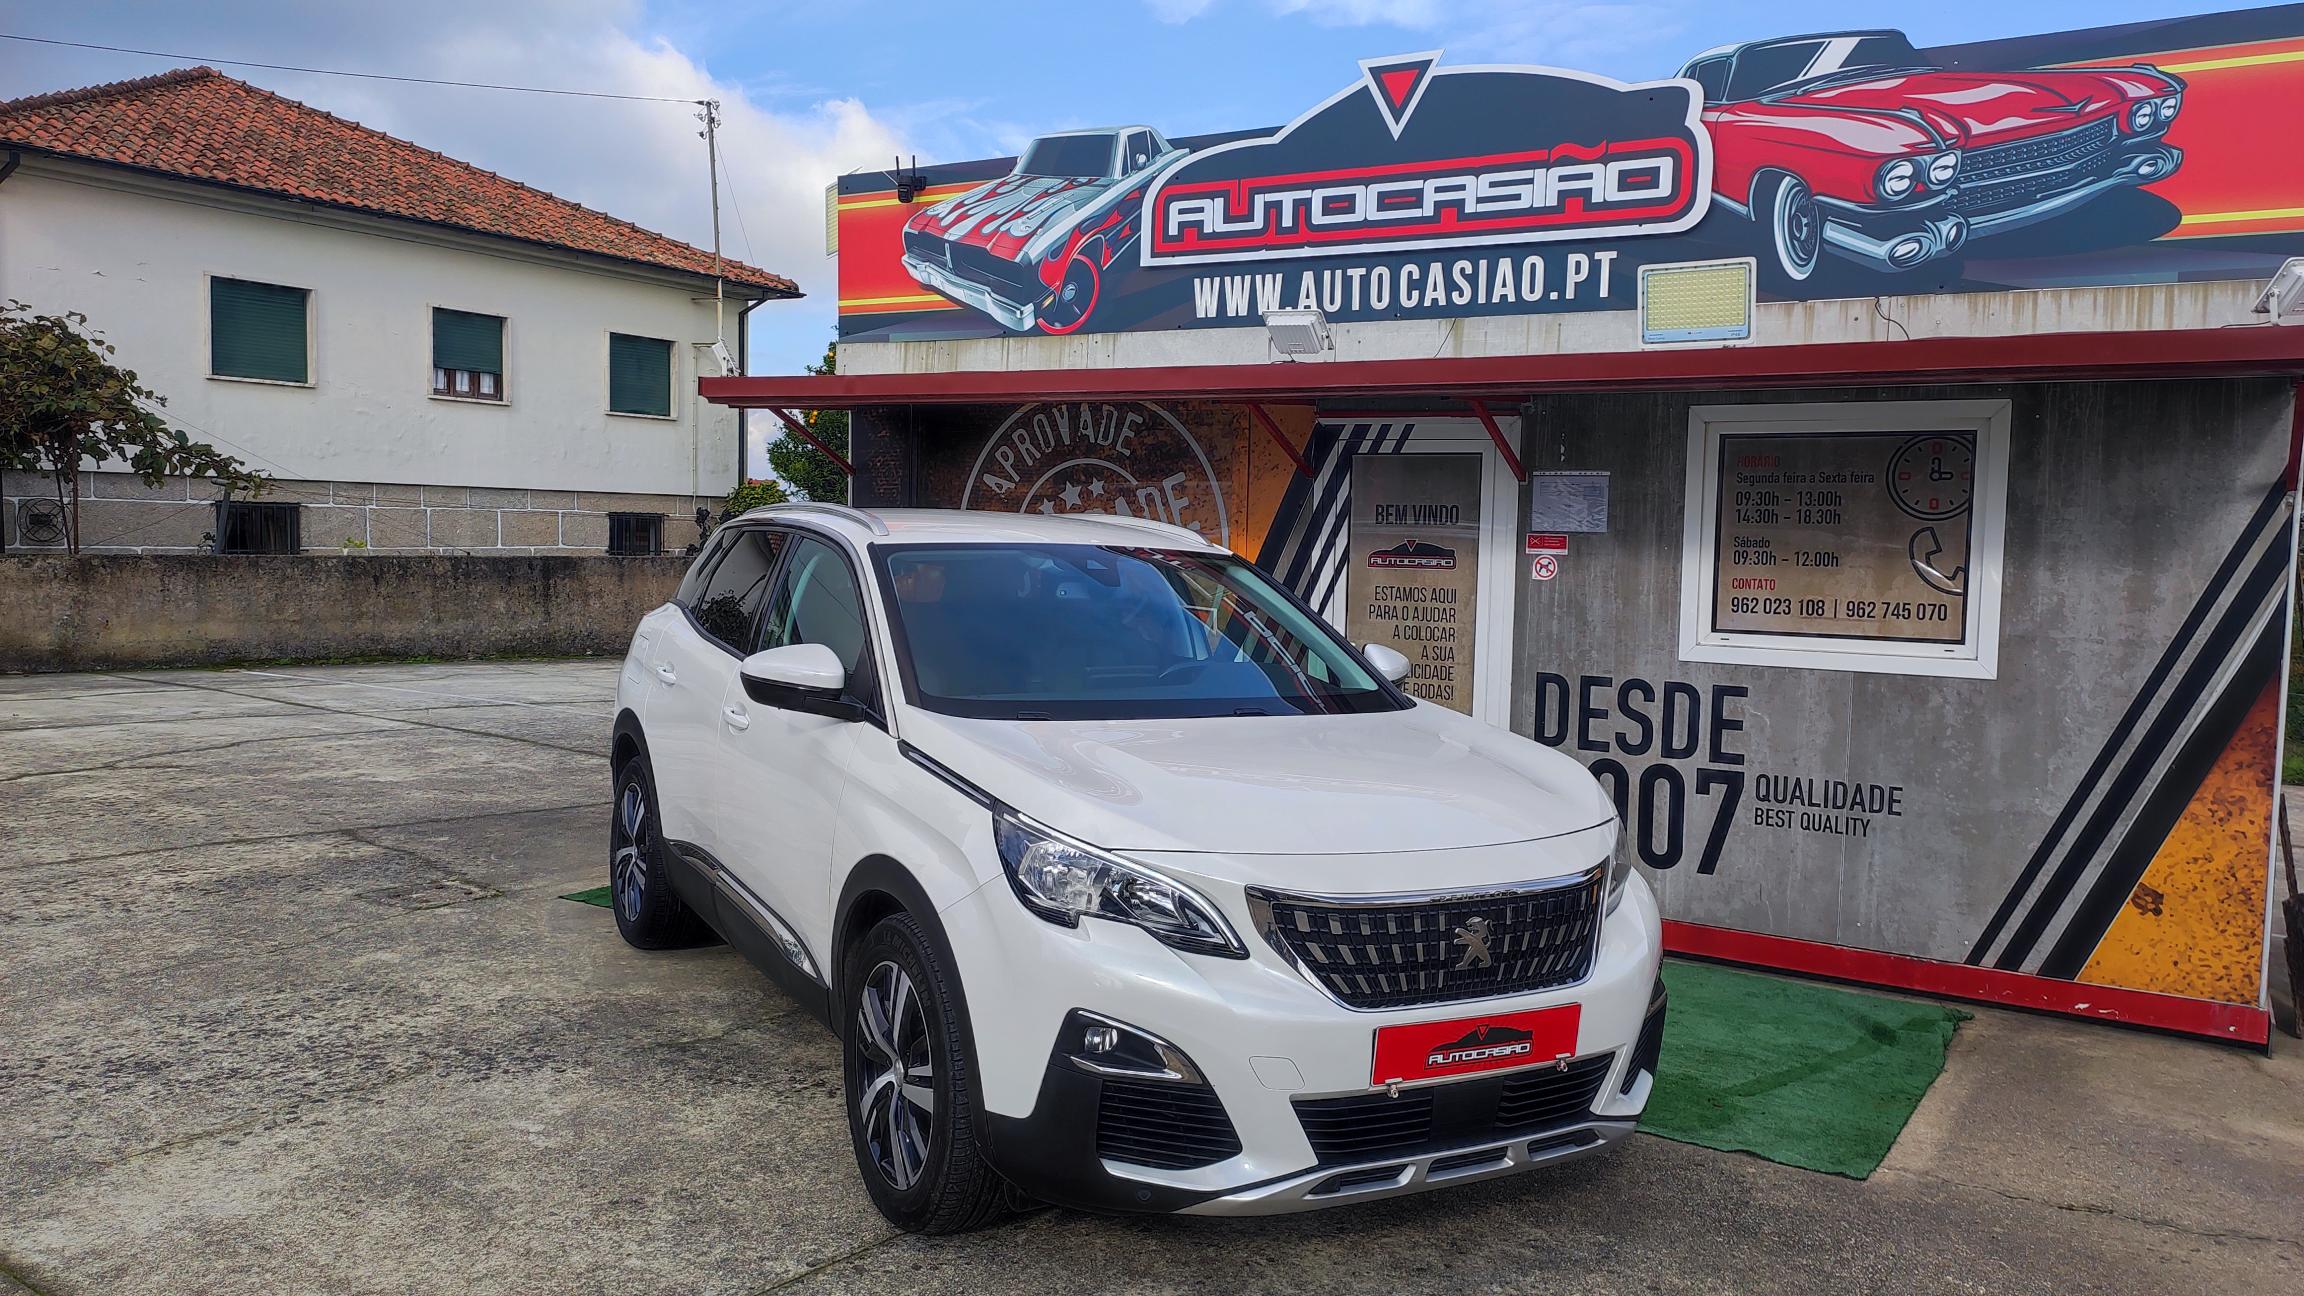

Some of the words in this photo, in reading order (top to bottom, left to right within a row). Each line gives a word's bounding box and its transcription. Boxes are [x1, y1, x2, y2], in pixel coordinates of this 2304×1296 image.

[1168, 141, 1674, 236] AUTOCASIÃO
[982, 402, 1144, 495] APROVADE
[1736, 471, 1780, 486] Segunda
[1782, 471, 1806, 484] feira
[1809, 474, 1816, 484] a
[1818, 471, 1847, 484] Sexta
[1850, 471, 1875, 484] feira
[1735, 490, 1780, 507] 09:30h
[1797, 490, 1842, 507] 13:00h
[1375, 504, 1408, 525] BEM
[1412, 504, 1460, 526] VINDO
[1735, 507, 1779, 525] 14:30h
[1796, 508, 1841, 525] 18.30h
[1733, 536, 1771, 549] Sábado
[1733, 550, 1777, 566] 09:30h
[1794, 551, 1839, 568] 12:00h
[1732, 577, 1776, 591] CONTATO
[1374, 585, 1427, 603] ESTAMOS
[1430, 587, 1457, 604] AQUI
[1368, 603, 1399, 621] PARA
[1401, 605, 1409, 621] O
[1412, 606, 1457, 624] AJUDAR
[1731, 596, 1759, 614] 962
[1763, 597, 1792, 615] 023
[1798, 599, 1825, 617] 108
[1846, 600, 1877, 619] 962
[1881, 601, 1912, 620] 745
[1916, 602, 1948, 621] 070
[1392, 624, 1401, 640] A
[1403, 624, 1456, 643] COLOCAR
[1420, 645, 1429, 661] A
[1431, 645, 1455, 662] SUA
[1412, 682, 1454, 701] RODAS!
[1534, 671, 1749, 766] DESDE
[1754, 773, 1904, 817] QUALIDADE
[1754, 807, 1796, 830] BEST
[1799, 812, 1871, 838] QUALITY
